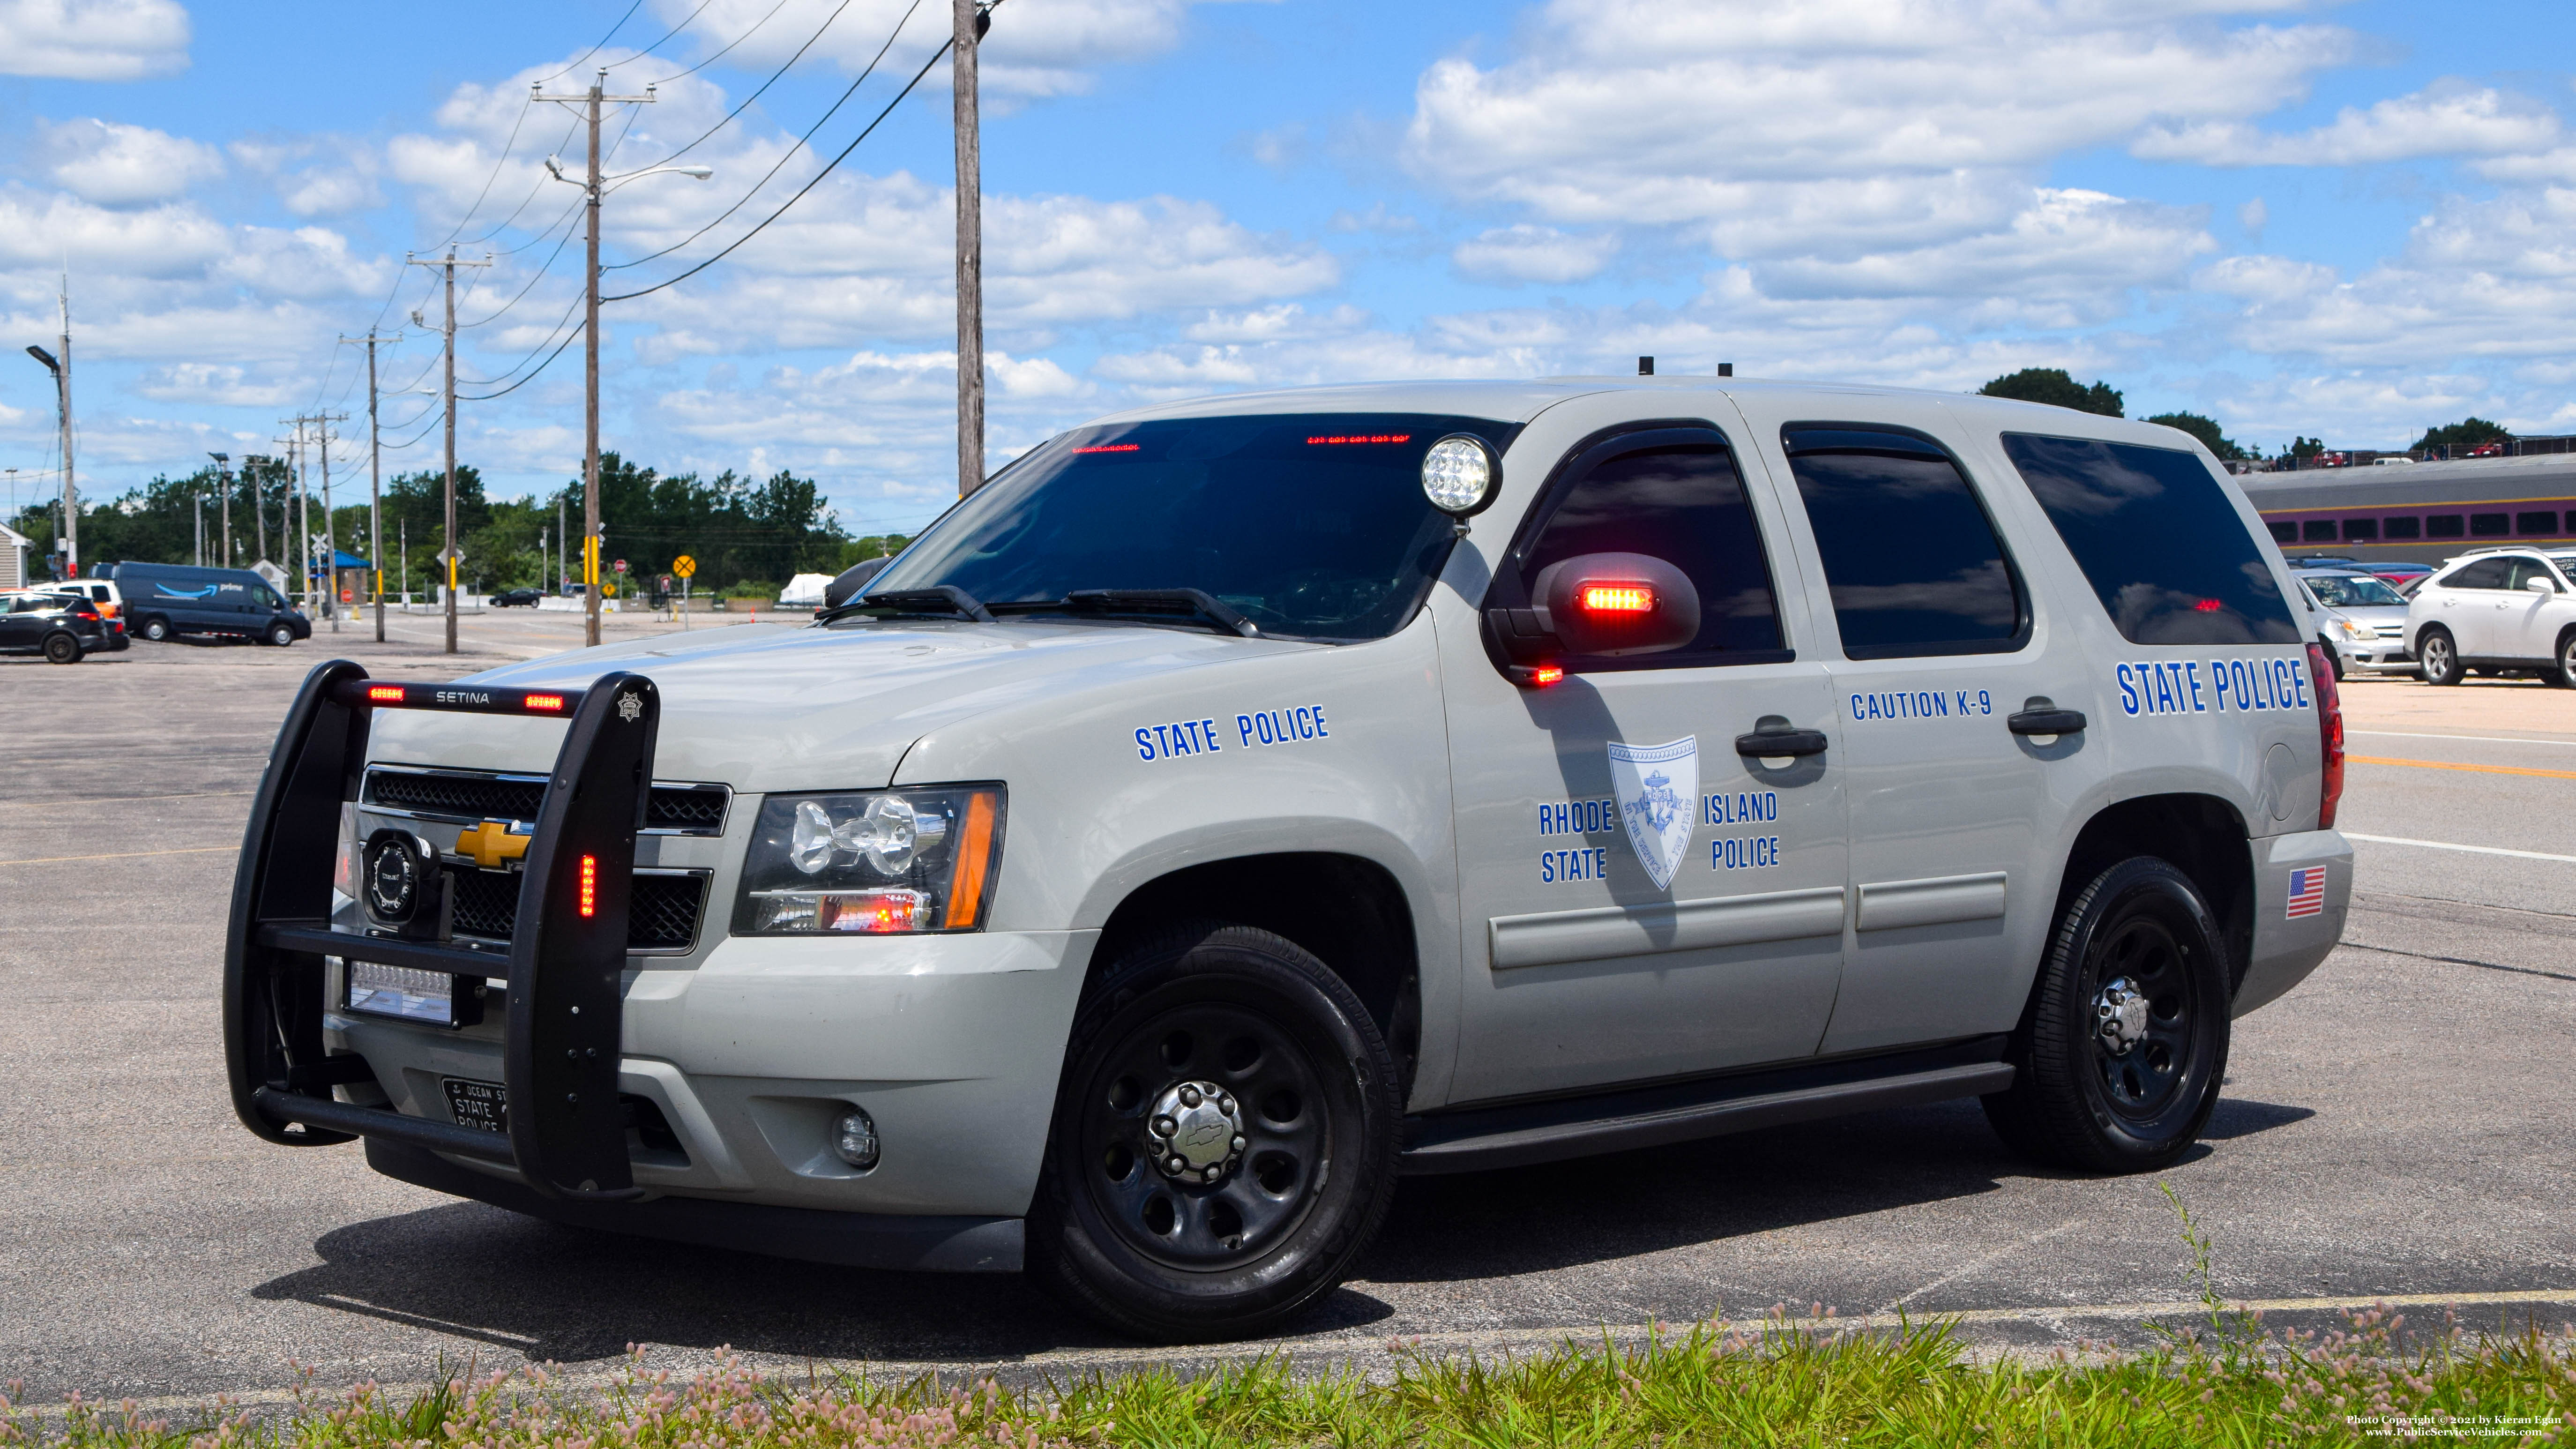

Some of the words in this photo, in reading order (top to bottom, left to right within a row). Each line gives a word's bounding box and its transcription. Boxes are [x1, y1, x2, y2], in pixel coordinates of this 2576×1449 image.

[220, 583, 244, 592] prime
[436, 691, 490, 704] SETINA
[2115, 659, 2207, 718] STATE
[2209, 657, 2309, 713] POLICE
[1851, 690, 1949, 720] CAUTION
[1955, 689, 1992, 717] K-9
[1134, 717, 1222, 762] STATE
[1235, 704, 1330, 749] POLICE
[1647, 791, 1668, 800] HOPE
[1538, 799, 1613, 836] RHODE
[1703, 791, 1777, 826] ISLAND
[1629, 815, 1641, 839] THE
[1638, 837, 1662, 875] SERVICE
[1672, 835, 1684, 857] THE
[1681, 798, 1693, 833] STATE
[1541, 847, 1606, 884] STATE
[1711, 836, 1779, 871] POLICE
[467, 1085, 492, 1099] OCEAN
[455, 1098, 493, 1118] STATE
